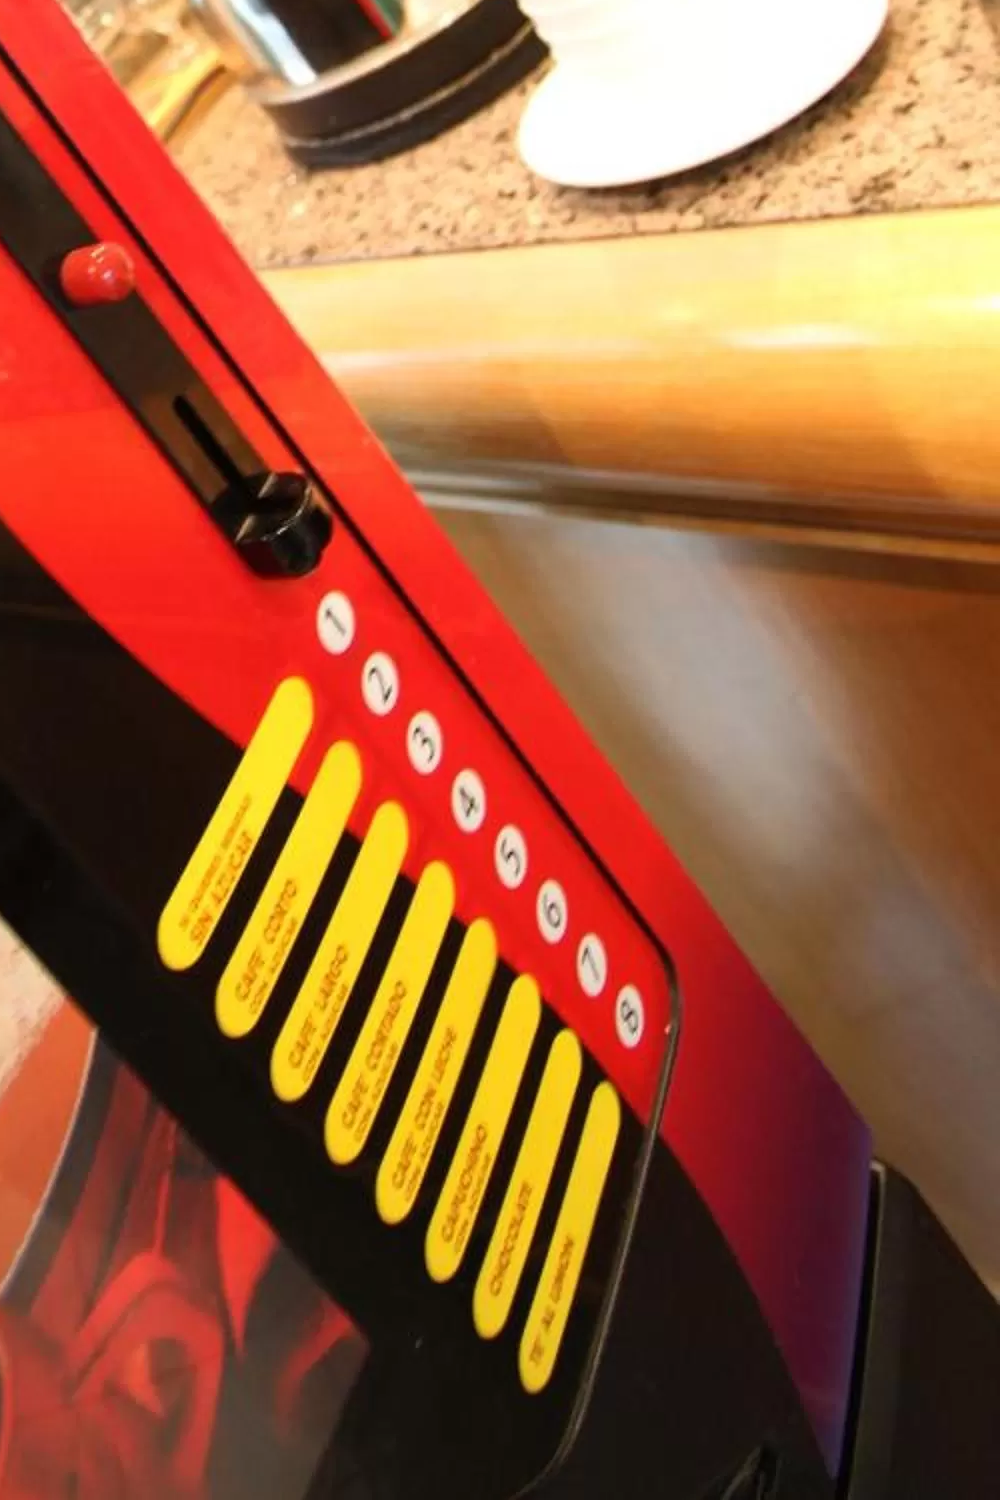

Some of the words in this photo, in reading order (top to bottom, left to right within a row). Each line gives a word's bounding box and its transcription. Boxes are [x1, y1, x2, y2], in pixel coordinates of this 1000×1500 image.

[189, 910, 213, 946] SIN
[210, 830, 252, 905] AZUCAR
[263, 877, 298, 944] CORTO
[315, 944, 348, 1011] LARGO
[366, 980, 407, 1072] CORTADO
[415, 1086, 437, 1131] CON
[433, 1025, 457, 1085] LECHE
[490, 1181, 532, 1297] CHOCOLATE
